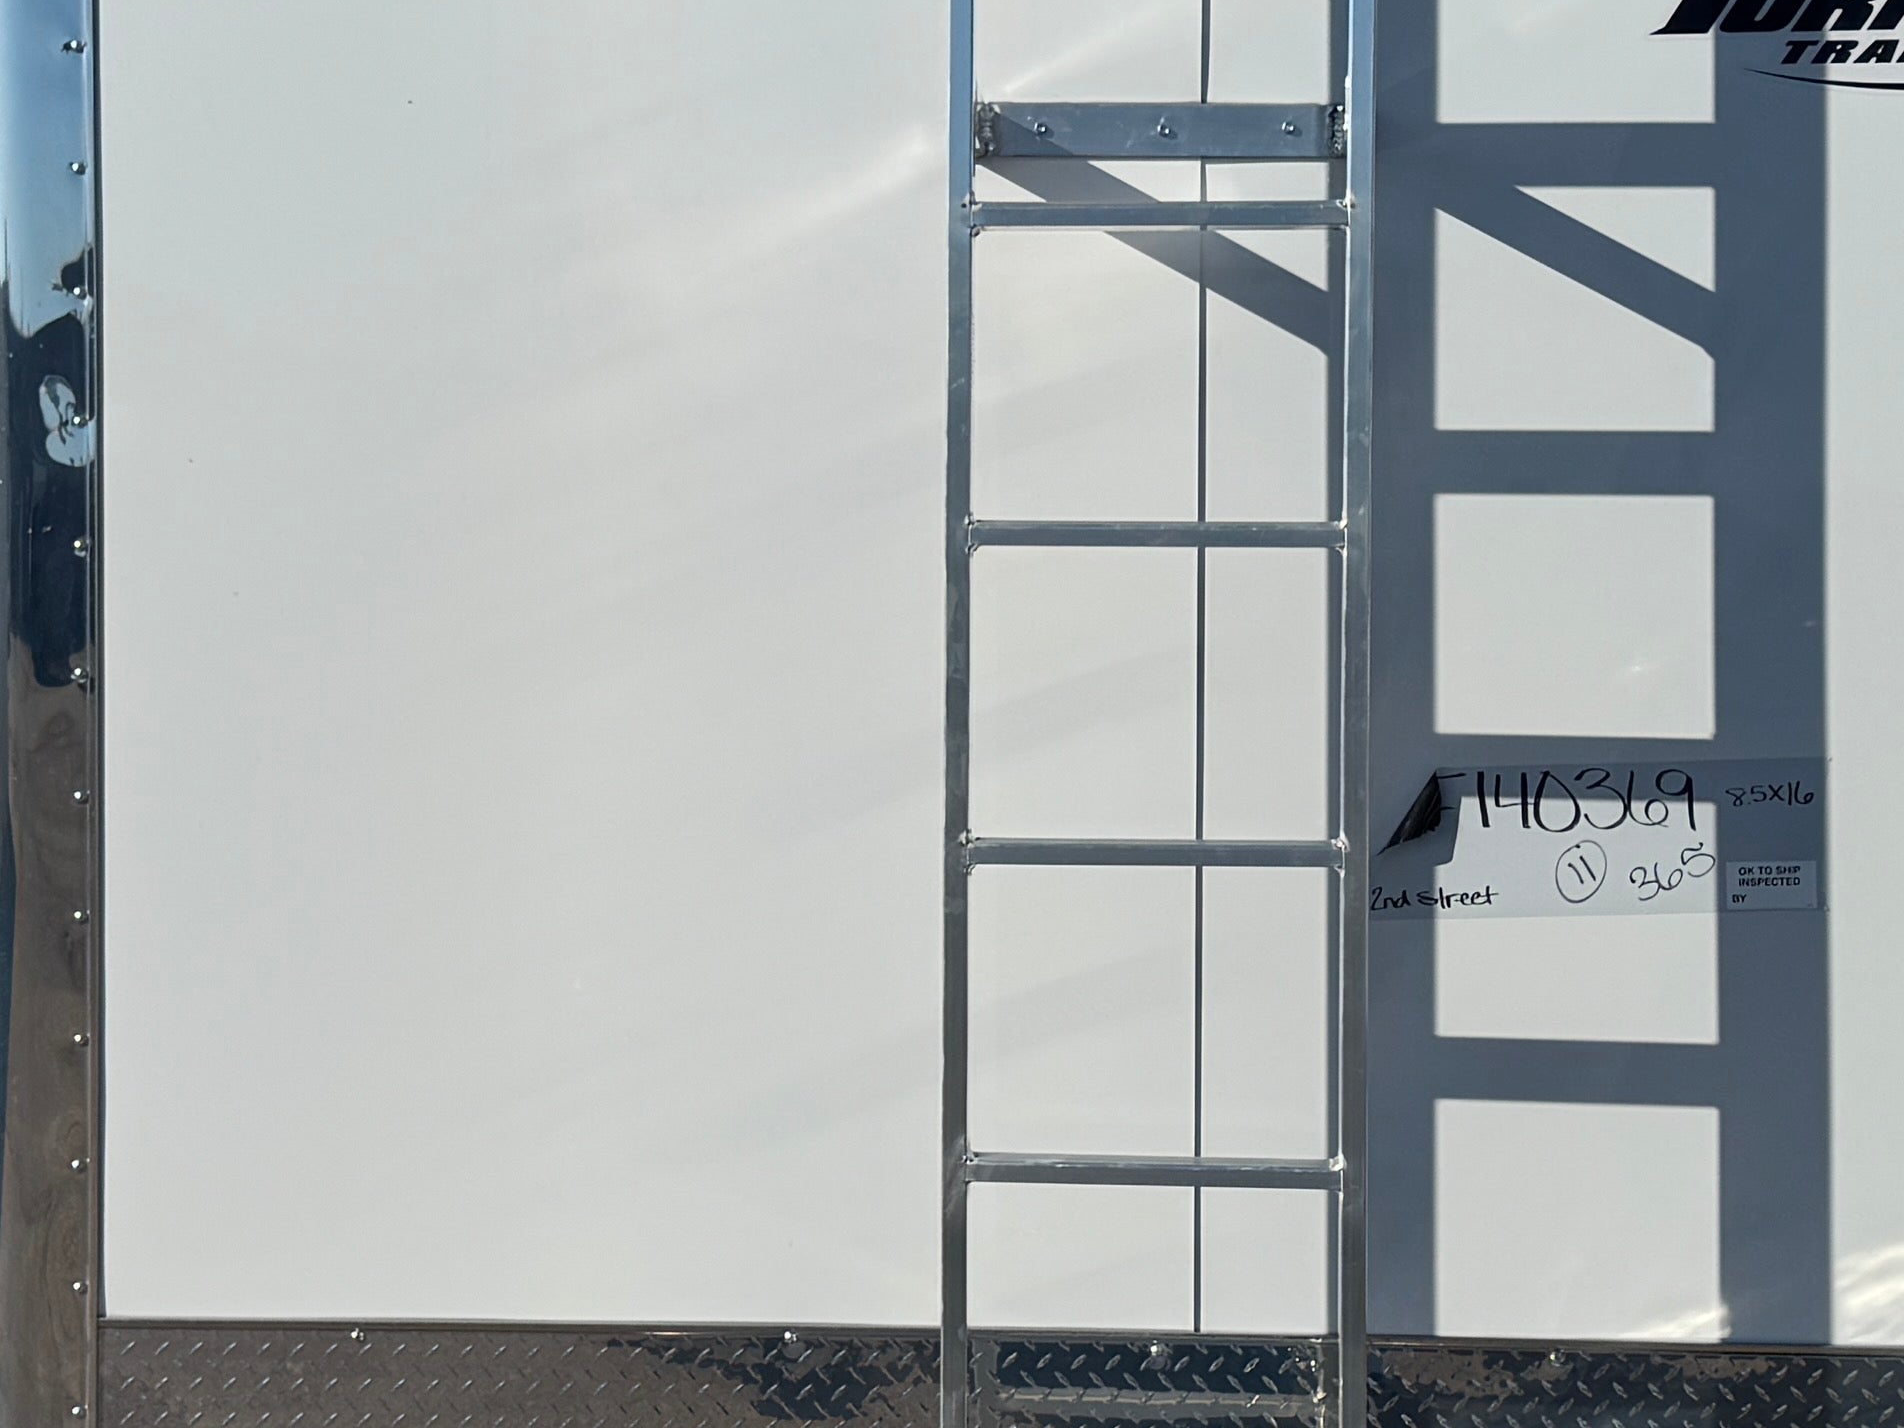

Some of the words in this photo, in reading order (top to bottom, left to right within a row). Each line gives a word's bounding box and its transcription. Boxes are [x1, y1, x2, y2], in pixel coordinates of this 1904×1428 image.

[1738, 866, 1756, 876] OK
[1757, 866, 1773, 876] TO
[1738, 876, 1801, 887] INSPECTED
[1371, 886, 1412, 911] 2nd
[1732, 894, 1747, 903] BY
